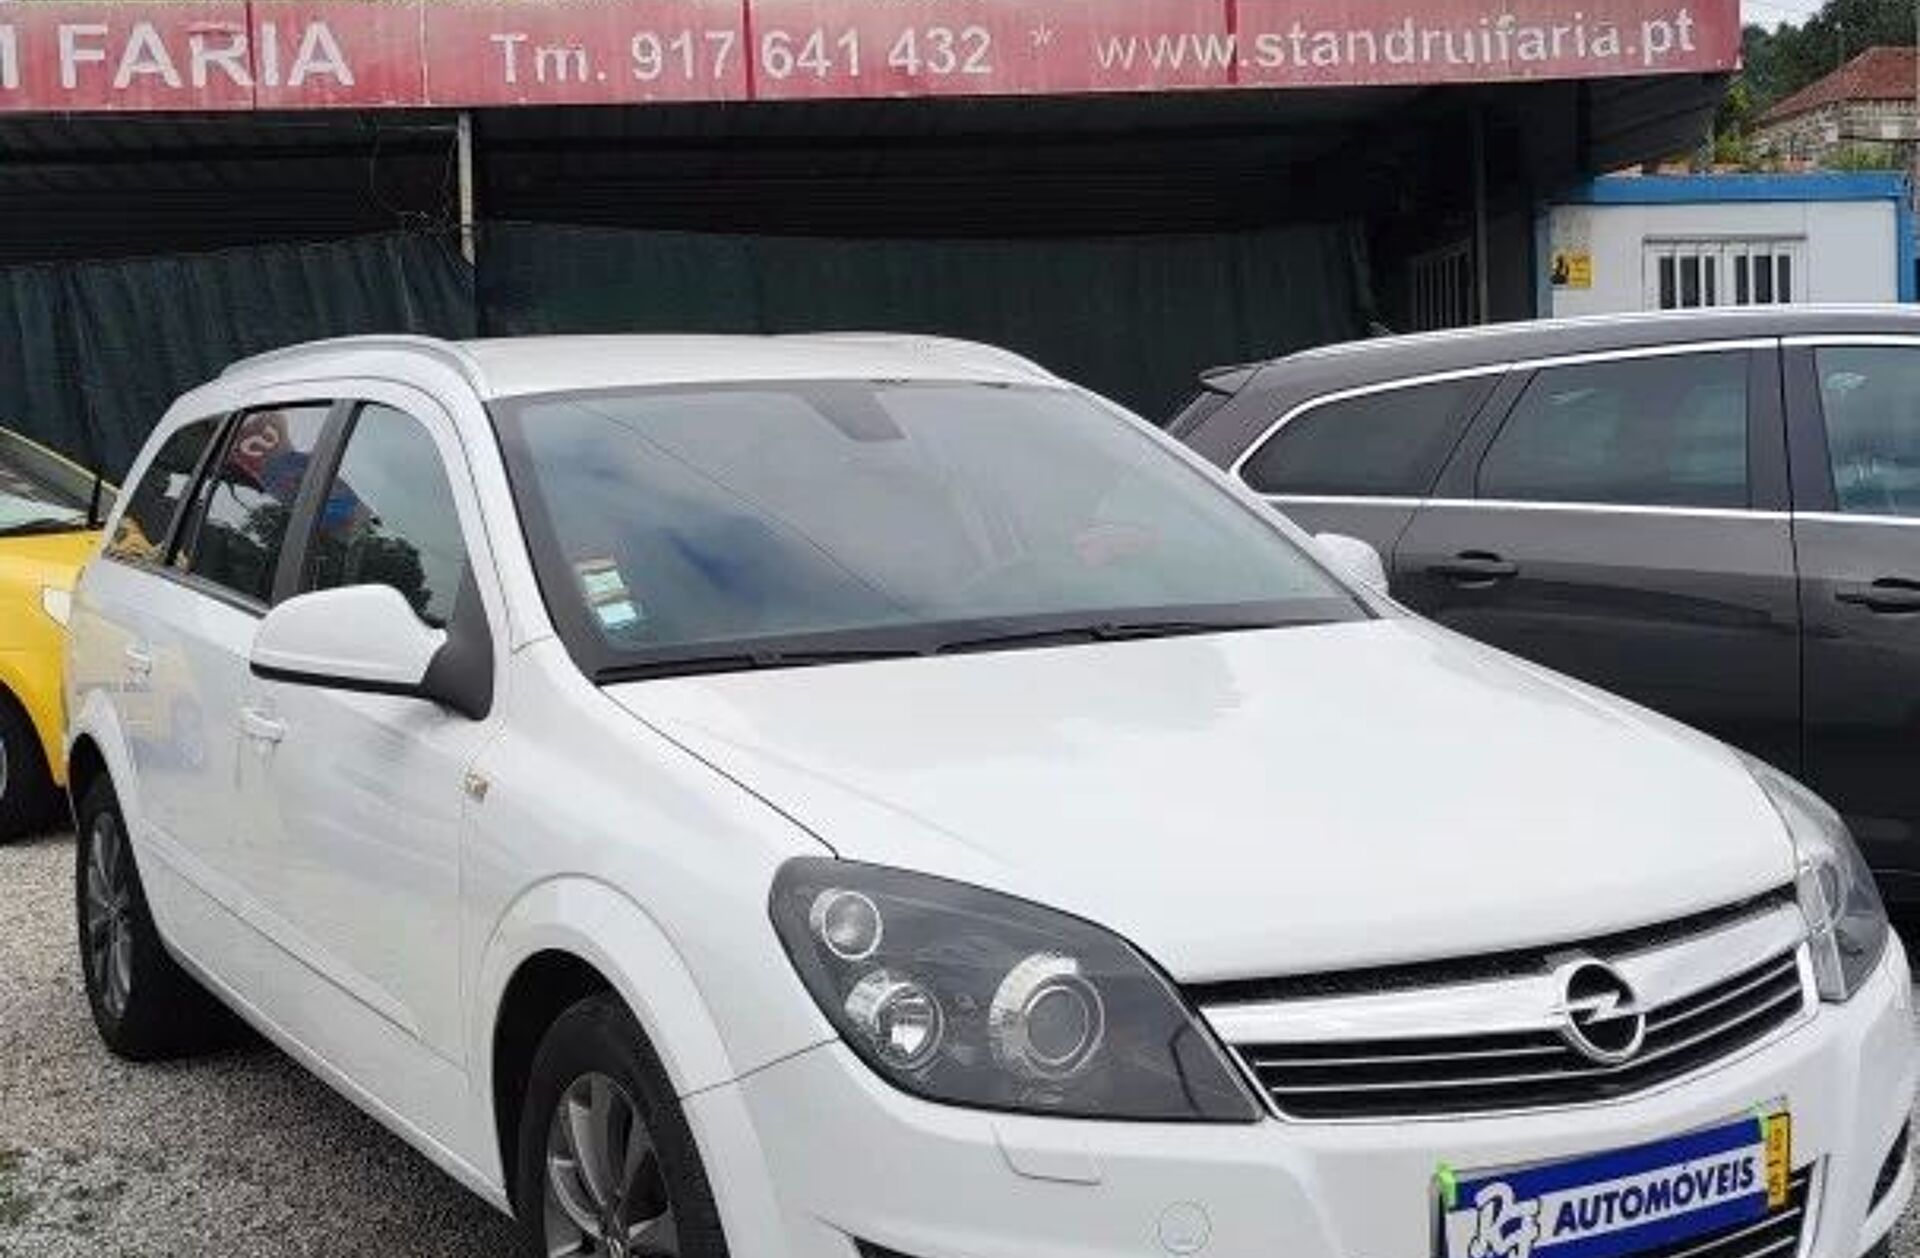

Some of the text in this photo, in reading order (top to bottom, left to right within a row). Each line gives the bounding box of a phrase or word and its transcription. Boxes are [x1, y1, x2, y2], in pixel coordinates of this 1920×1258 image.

[59, 21, 355, 89] FARIA
[490, 33, 607, 84] Tm.
[631, 30, 736, 80] 917
[761, 28, 860, 79] 641
[887, 26, 993, 76] 432
[1097, 8, 1696, 69] www.standruifaria.pt
[1553, 1156, 1754, 1236] AUTOMÓVEIS
